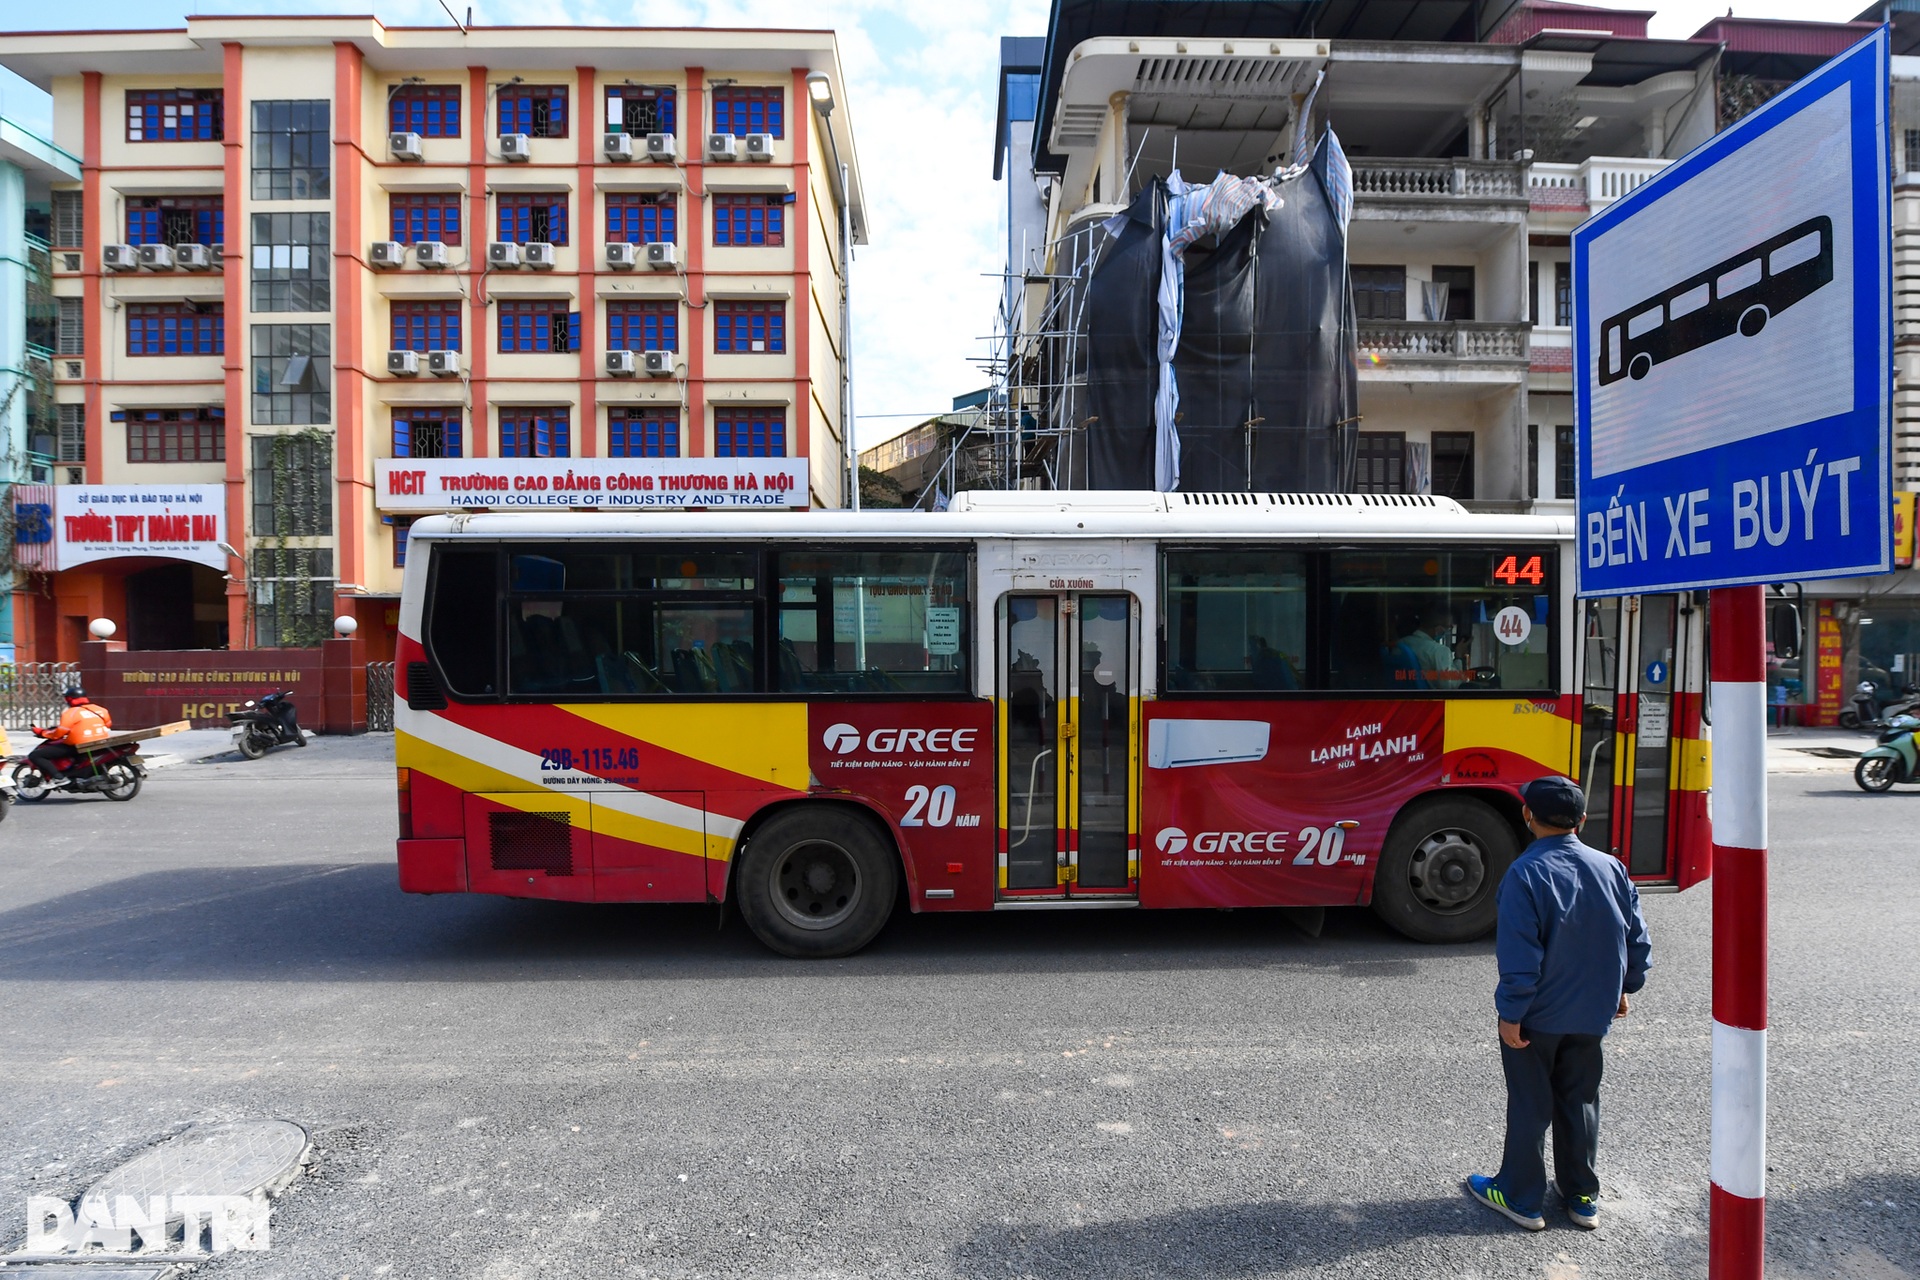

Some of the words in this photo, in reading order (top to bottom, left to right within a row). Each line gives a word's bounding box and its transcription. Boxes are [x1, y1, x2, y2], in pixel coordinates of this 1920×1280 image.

[389, 471, 426, 495] HCIT
[440, 472, 509, 491] TRƯỜNG
[513, 476, 548, 491] CAO
[552, 470, 600, 491] ĐẲNG
[606, 473, 654, 491] CÔNG
[659, 474, 728, 491] THƯƠNG
[734, 472, 759, 490] HÀ
[764, 472, 794, 493] NỘI
[91, 493, 109, 503] GIÁO
[112, 494, 127, 505] DỤC
[129, 493, 139, 503] VÀ
[158, 494, 173, 505] TẠO
[175, 493, 186, 503] HÀ
[189, 494, 203, 505] NỘI
[451, 495, 500, 505] HANOI
[505, 495, 579, 505] COLLEGE
[583, 495, 604, 504] OF
[609, 495, 686, 505] INDUSTRY
[692, 495, 725, 504] AND
[730, 494, 785, 504] TRADE
[1587, 484, 1648, 569] BẾN
[1663, 488, 1711, 560] XE
[1733, 448, 1861, 550] BUÝT
[115, 515, 145, 542] THPT
[148, 508, 190, 542] HOÀNG
[192, 515, 217, 542] MAI
[1067, 576, 1094, 588] XUỐNG
[1495, 556, 1543, 585] 44
[1500, 614, 1523, 638] 44
[158, 672, 176, 682] CAO
[206, 670, 230, 682] CÔNG
[269, 670, 281, 682] HÀ
[182, 703, 240, 719] HCIT
[1513, 702, 1556, 715] BS090
[866, 728, 978, 753] GREE
[1346, 722, 1381, 740] LẠNH
[541, 748, 639, 771] 29B-115.46
[1311, 743, 1353, 764] LẠNH
[1360, 734, 1417, 763] LẠNH
[830, 759, 844, 768] TIẾT
[845, 760, 862, 770] KIỆM
[864, 760, 880, 770] ĐIỆN
[882, 759, 903, 768] NĂNG
[909, 760, 924, 769] VẬN
[926, 759, 946, 767] HÀNH
[543, 775, 566, 784] ĐƯỜNG
[567, 776, 580, 784] DÂY
[582, 776, 602, 784] NÓNG:
[900, 784, 956, 827] 20
[955, 812, 980, 826] NĂM
[1192, 831, 1289, 853] GREE
[1292, 826, 1346, 866] 20
[1161, 858, 1172, 866] TIẾT
[1173, 858, 1188, 867] KIỆM
[1190, 859, 1204, 867] ĐIỆN
[1205, 858, 1224, 866] NĂNG
[1229, 858, 1242, 867] VẬN
[1243, 858, 1261, 866] HÀNH
